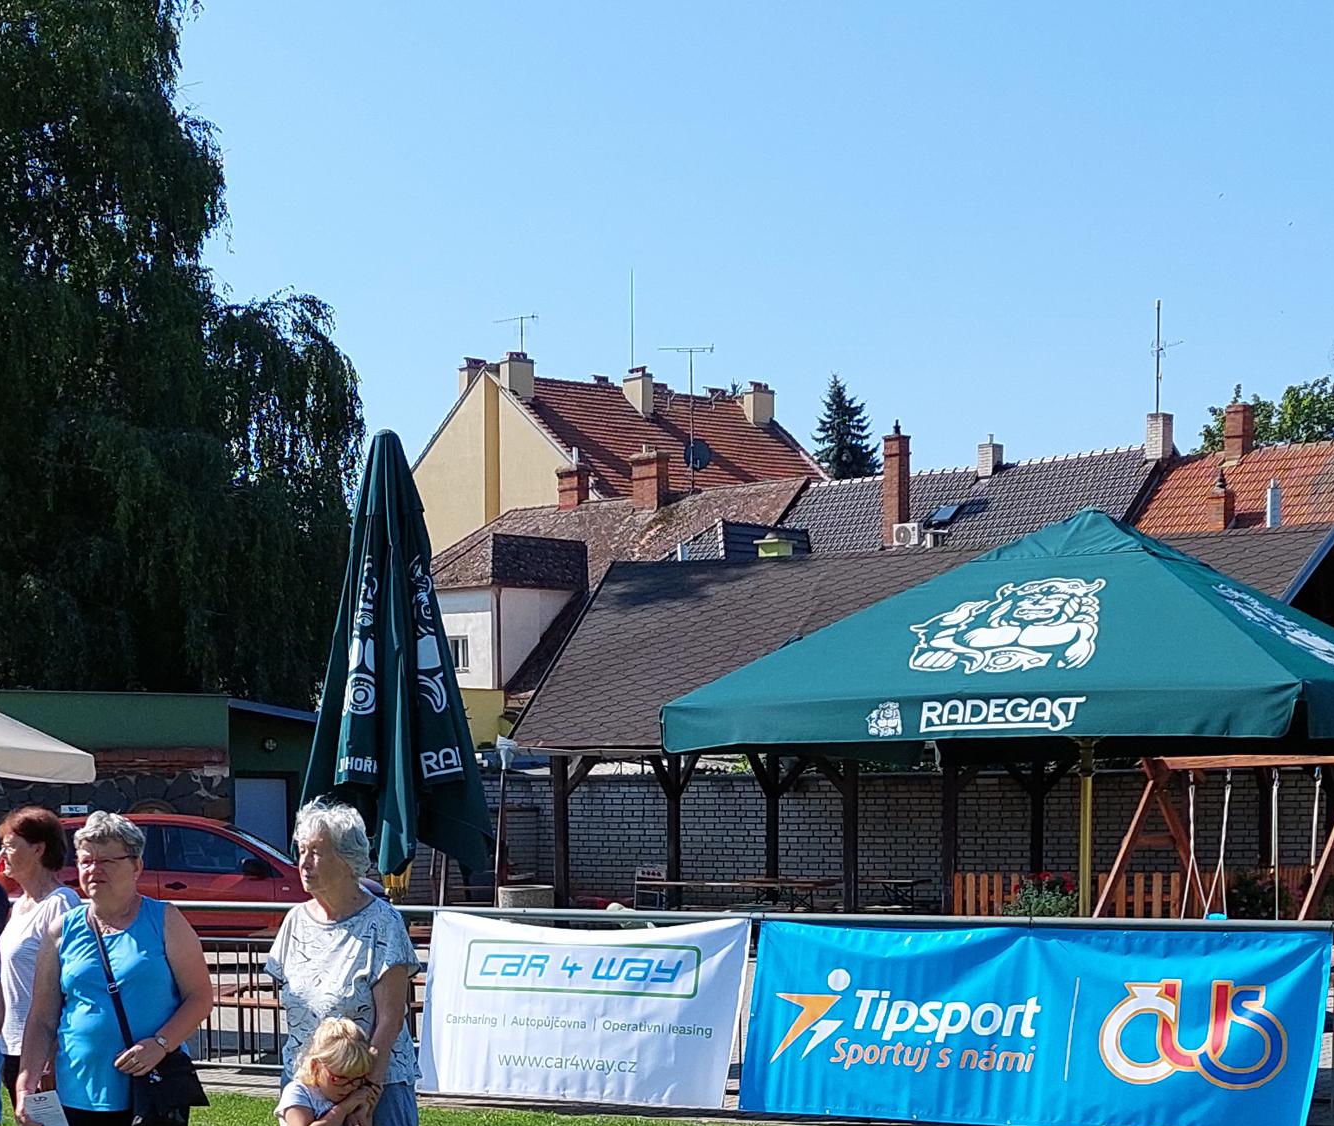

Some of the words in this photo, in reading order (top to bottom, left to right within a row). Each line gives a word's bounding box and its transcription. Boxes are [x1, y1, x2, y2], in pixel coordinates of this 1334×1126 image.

[919, 696, 1087, 733] RADEGAST
[420, 746, 463, 779] RA
[561, 956, 583, 978] 4
[446, 1013, 498, 1027] Carsharing
[510, 1015, 587, 1030] Autopůjčovna
[668, 1023, 713, 1039] leasing
[854, 989, 1042, 1043] Tipsport
[497, 1053, 637, 1076] www.car4way.cz
[830, 1037, 933, 1072] Sportuj
[936, 1047, 953, 1068] s
[958, 1043, 1037, 1073] námi
